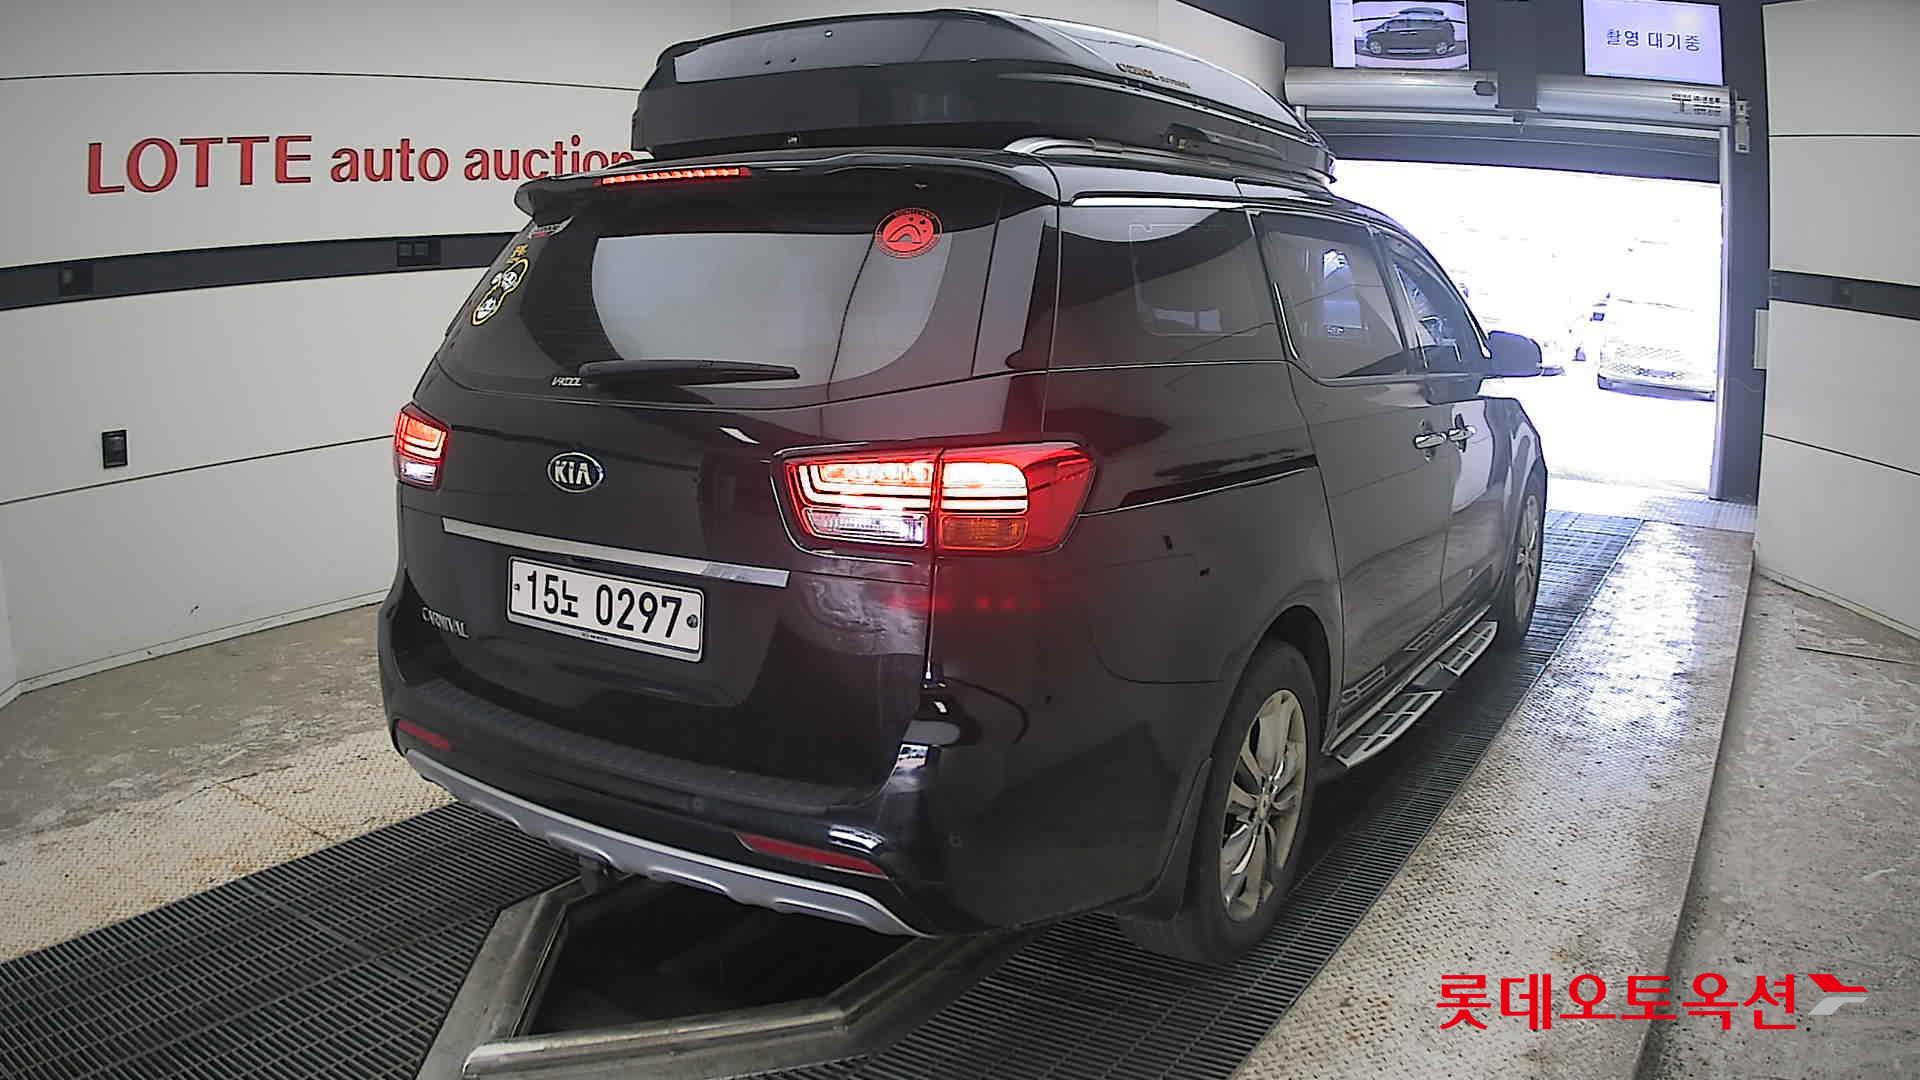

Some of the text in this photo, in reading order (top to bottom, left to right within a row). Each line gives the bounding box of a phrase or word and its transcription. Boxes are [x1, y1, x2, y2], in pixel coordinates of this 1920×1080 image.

[1607, 28, 1640, 47] 촬영
[87, 135, 312, 194] LOTTE
[330, 138, 450, 183] auto
[554, 459, 593, 486] KIA
[526, 570, 683, 639] 15노 0297
